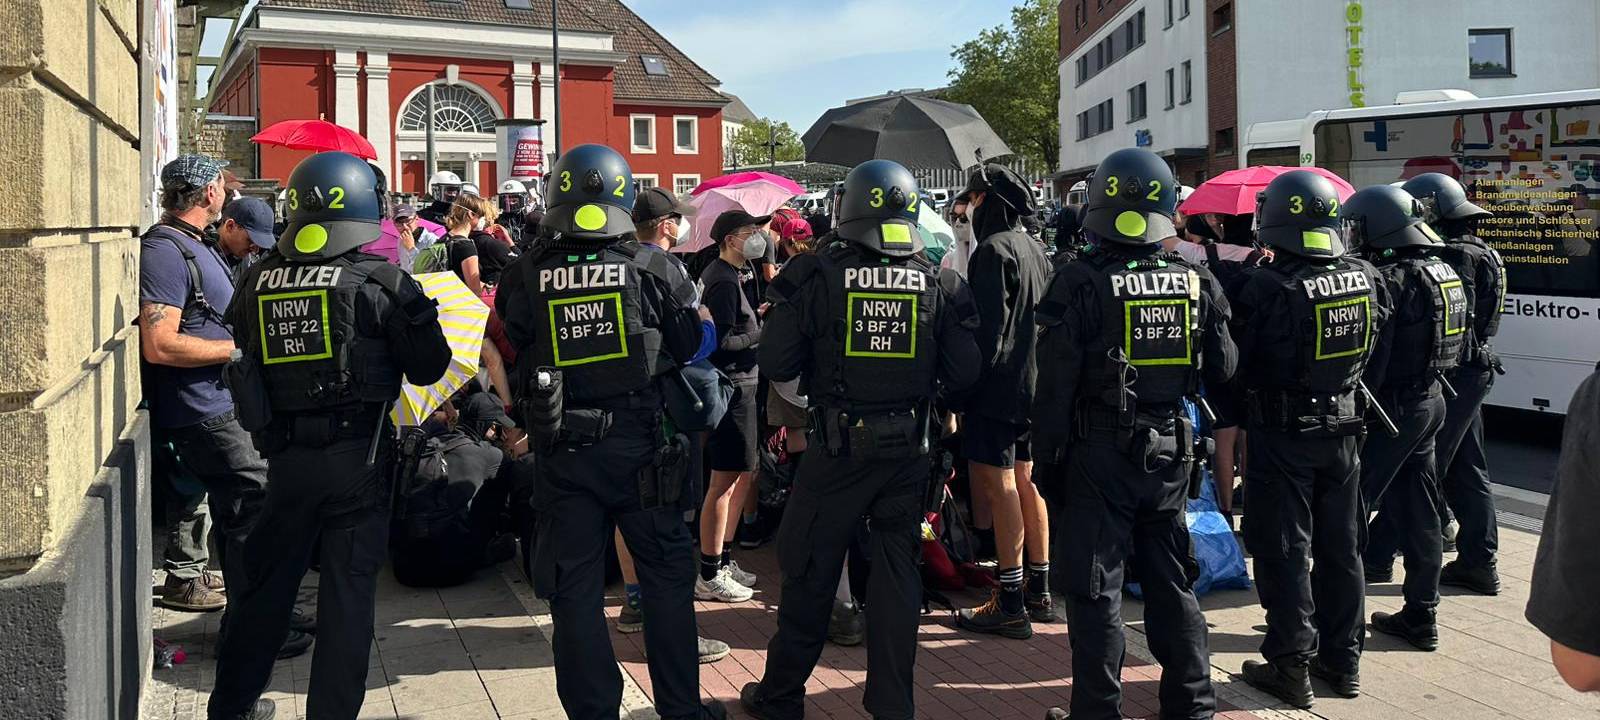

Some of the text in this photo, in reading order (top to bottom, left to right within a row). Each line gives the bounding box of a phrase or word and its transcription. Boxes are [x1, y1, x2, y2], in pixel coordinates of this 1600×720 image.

[560, 170, 626, 198] 3 2
[1105, 176, 1162, 201] 3 2
[1475, 178, 1544, 187] Alarmanlagen
[289, 187, 345, 210] 3 2
[869, 187, 917, 213] 3 2
[1475, 190, 1577, 200] Brandmeldeanlagen
[1289, 195, 1338, 217] 3 2
[1479, 203, 1574, 213] ideoüberwachung
[1516, 217, 1536, 225] und
[1538, 216, 1593, 225] Schlösser
[1476, 228, 1599, 238] Mechanische Sicherheit
[255, 265, 343, 291] POLIZEI
[539, 264, 626, 293] POLIZEI
[845, 267, 926, 292] POLIZEI
[1303, 270, 1370, 299] POLIZEI
[272, 299, 310, 319] NRW
[564, 302, 605, 323] NRW
[863, 301, 902, 318] NRW
[1140, 307, 1176, 324] NRW
[1328, 305, 1360, 324] NRW
[1501, 299, 1589, 319] Elektro-
[268, 319, 319, 337] 3 BF 22
[560, 321, 614, 340] 3 BF 22
[855, 320, 907, 334] 3 BF 21
[1134, 326, 1182, 340] 3 BF 22
[1324, 321, 1364, 339] 3 BF 21
[284, 337, 305, 354] RH
[870, 336, 891, 350] RH
